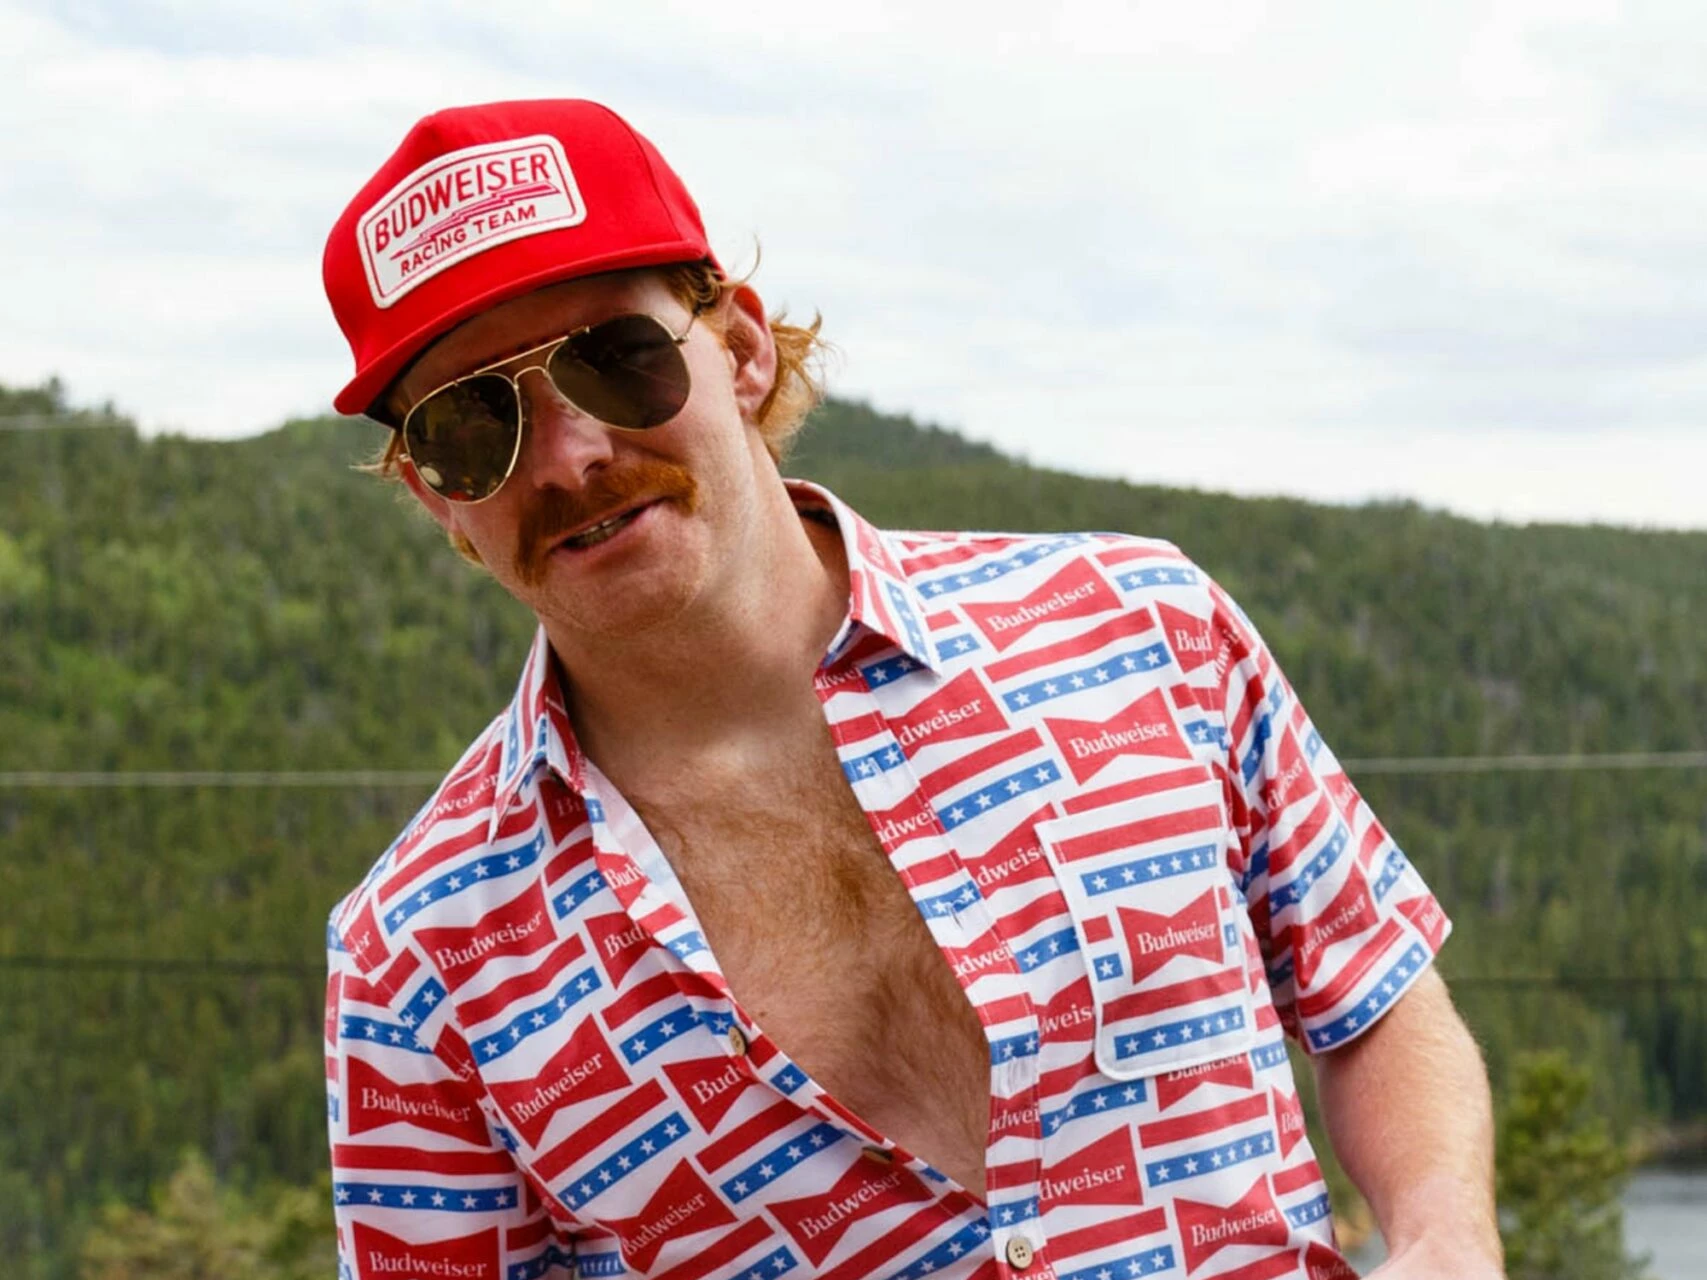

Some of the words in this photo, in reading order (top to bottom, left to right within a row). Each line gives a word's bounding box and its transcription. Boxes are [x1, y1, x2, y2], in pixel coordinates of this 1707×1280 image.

[374, 152, 551, 253] BUDWEISER
[401, 227, 467, 277] RACING
[473, 204, 537, 236] TEAM
[986, 580, 1097, 634] Budweiser
[1069, 721, 1170, 759] Budweiser
[435, 910, 543, 971] Budweiser
[1136, 921, 1217, 955] Budweiser
[361, 1087, 471, 1123] Budweiser
[510, 1053, 604, 1124] Budweiser
[797, 1173, 904, 1240] Budweiser
[1191, 1207, 1279, 1247] Budweiser
[369, 1252, 487, 1278] Budweiser
